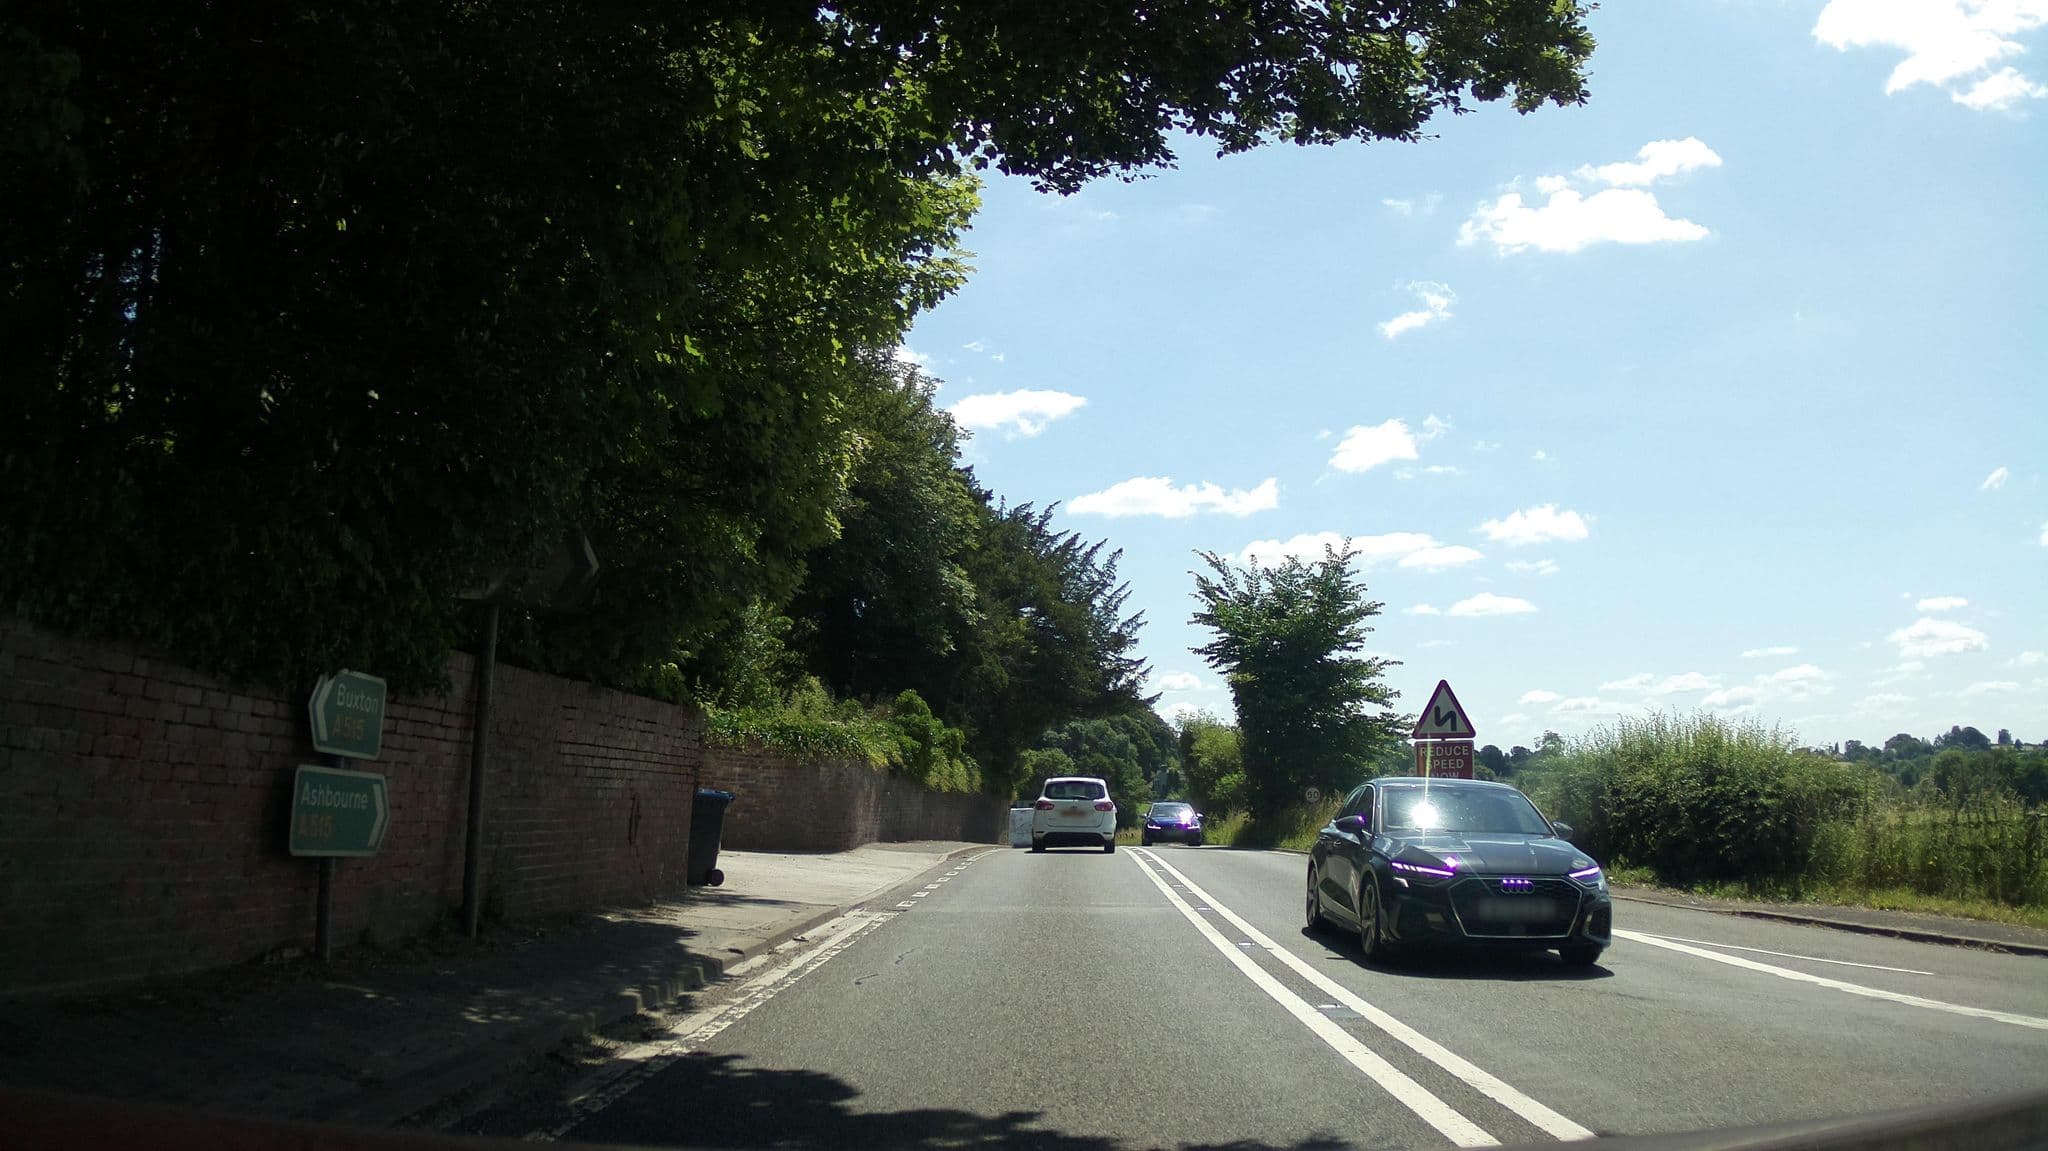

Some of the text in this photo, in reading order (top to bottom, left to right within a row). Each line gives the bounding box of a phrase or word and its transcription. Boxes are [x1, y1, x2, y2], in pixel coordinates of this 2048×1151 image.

[336, 683, 379, 713] Buxton
[1420, 745, 1469, 757] REDUCE
[301, 781, 369, 810] Ashbourne
